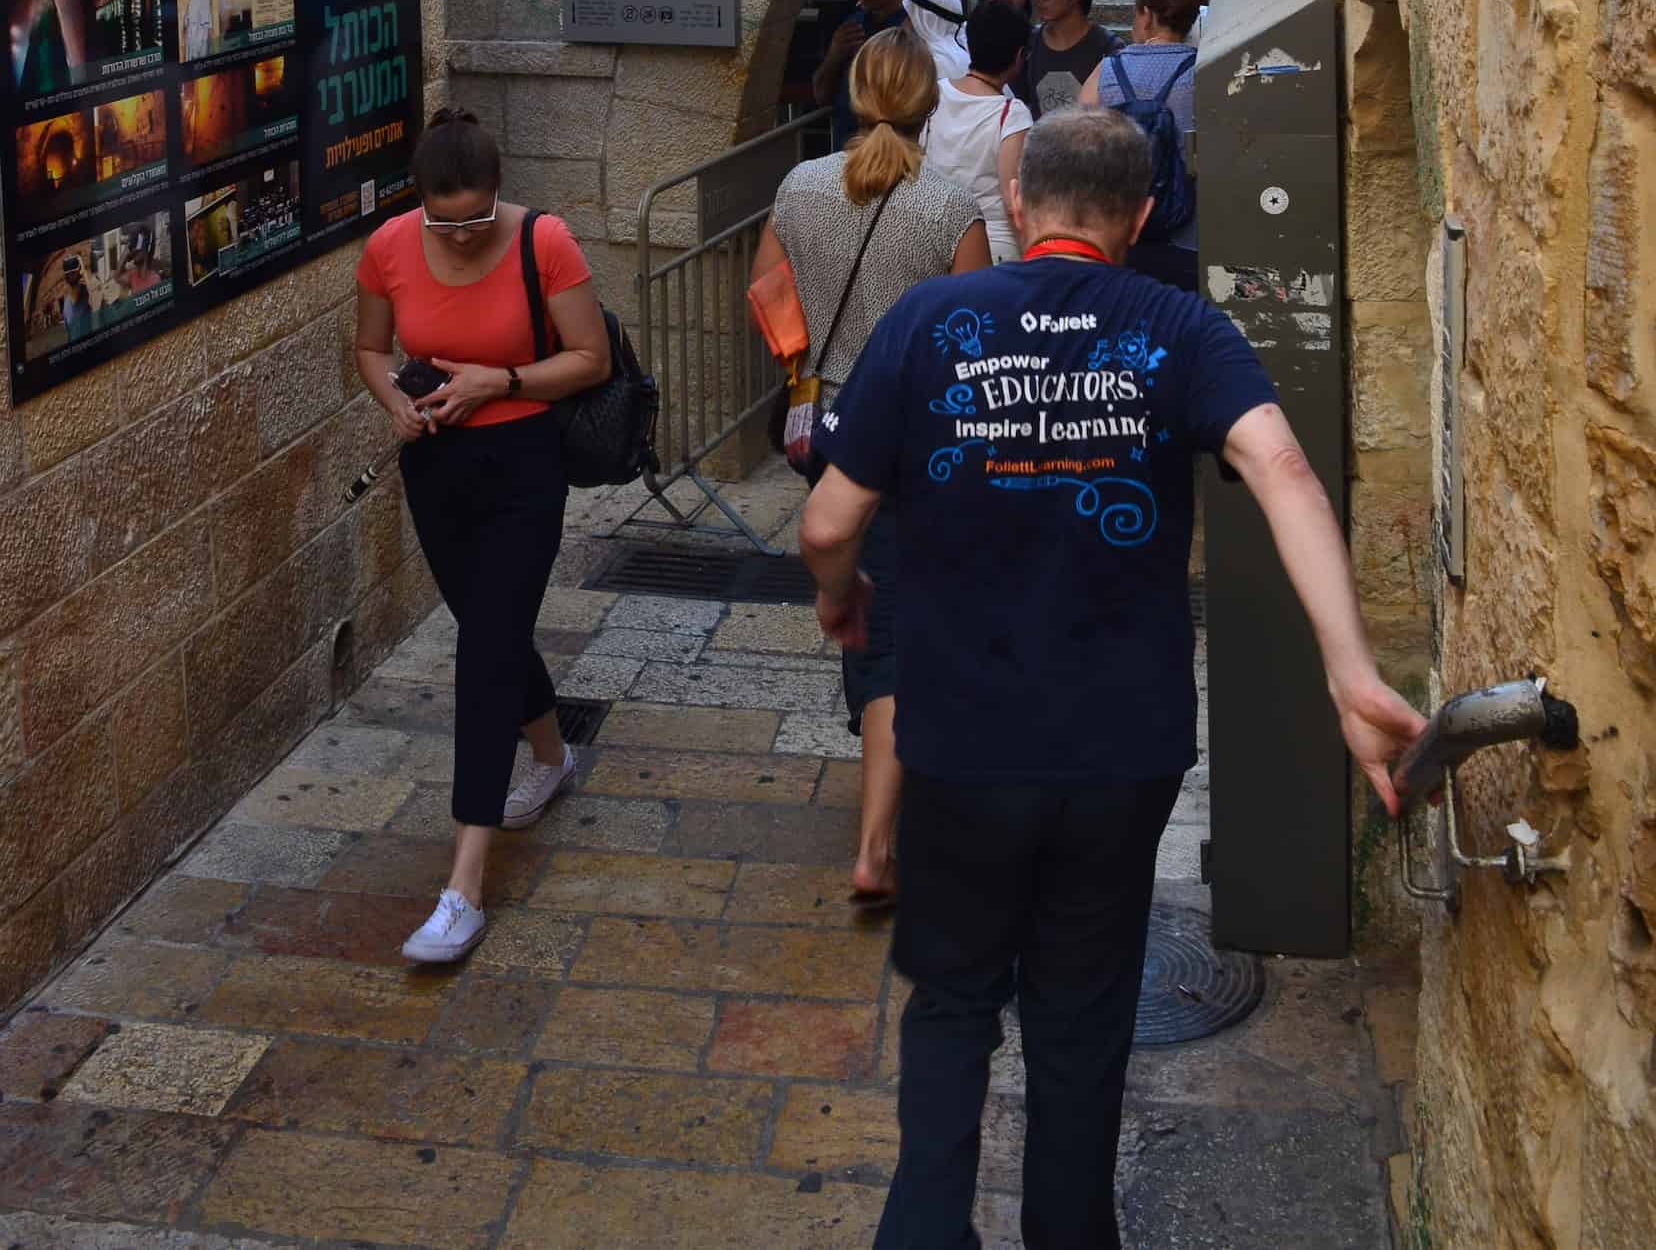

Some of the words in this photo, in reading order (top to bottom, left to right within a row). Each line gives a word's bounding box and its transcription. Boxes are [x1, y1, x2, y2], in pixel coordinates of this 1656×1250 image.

[323, 0, 399, 66] הכותל
[317, 54, 408, 126] המערבי
[1039, 312, 1097, 334] Follett
[955, 354, 1051, 381] Empower
[981, 369, 1145, 411] EDUCATORS.
[955, 418, 1033, 441] Inspire
[985, 456, 1116, 475] FollettLarning.com
